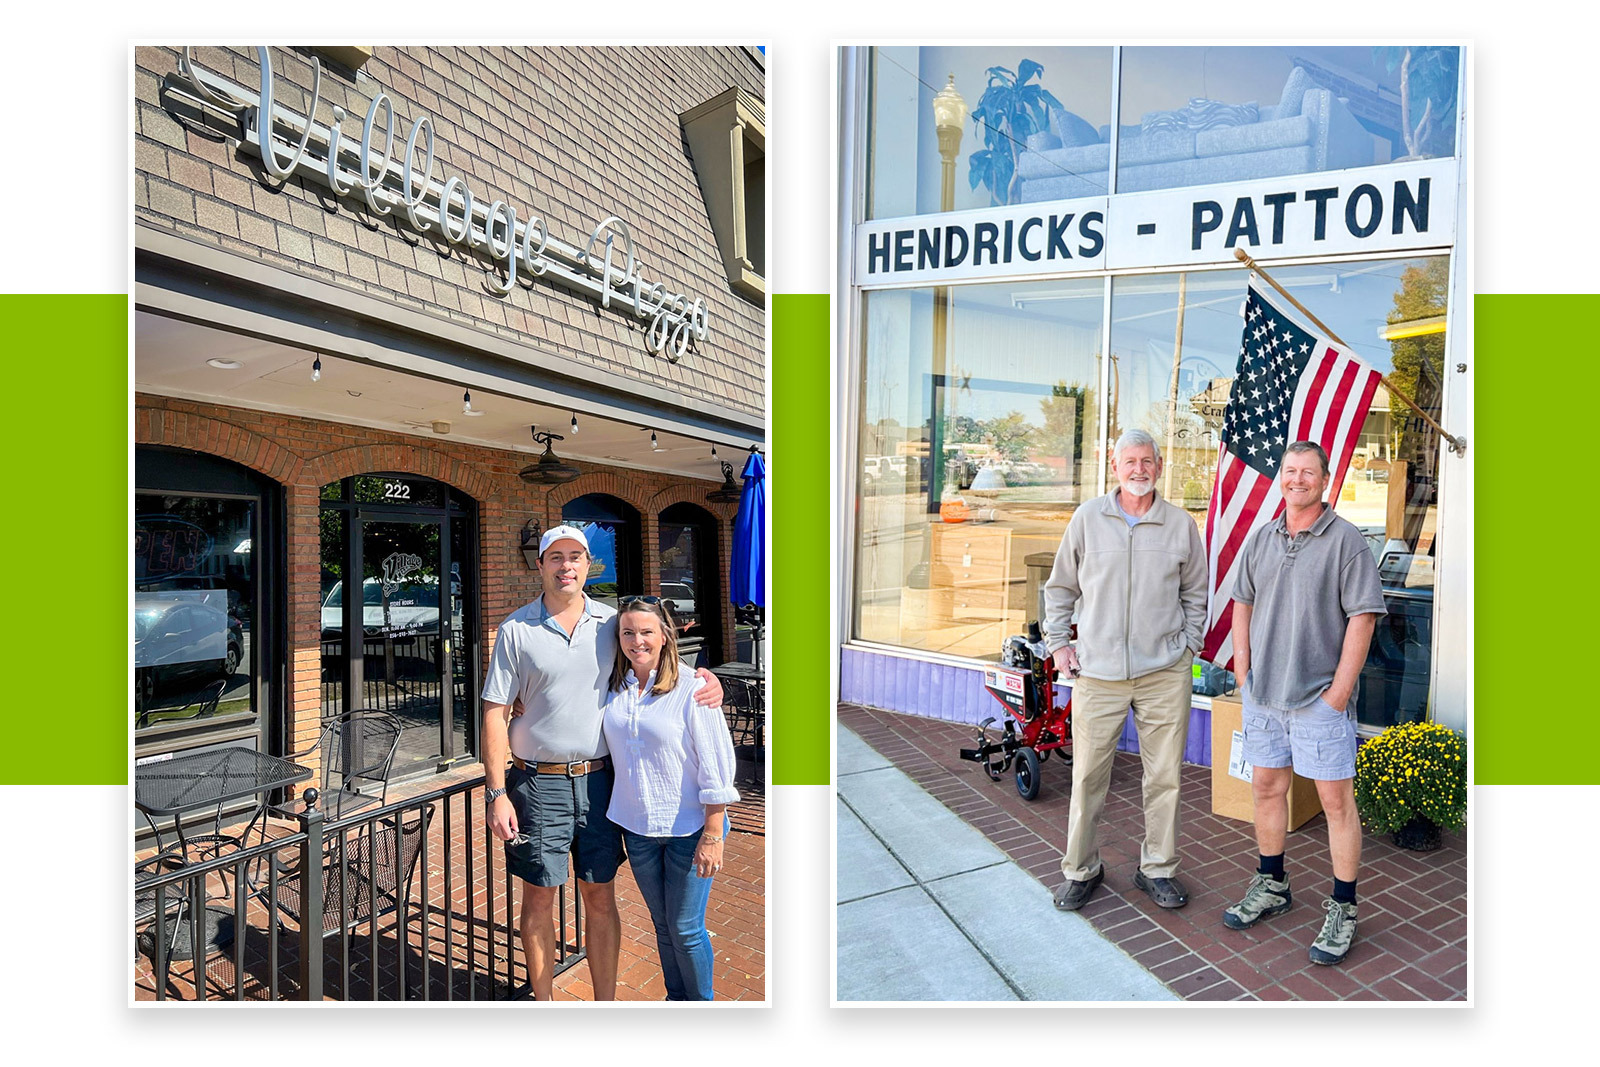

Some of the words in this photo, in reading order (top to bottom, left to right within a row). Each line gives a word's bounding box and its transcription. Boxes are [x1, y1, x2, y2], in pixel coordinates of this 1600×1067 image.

[182, 46, 548, 294] Village
[582, 216, 709, 361] Pizza
[869, 211, 1104, 274] HENDRICKS
[1137, 223, 1156, 235] -
[1191, 177, 1431, 250] PATTON
[385, 483, 410, 499] 222
[135, 529, 200, 572] PEN
